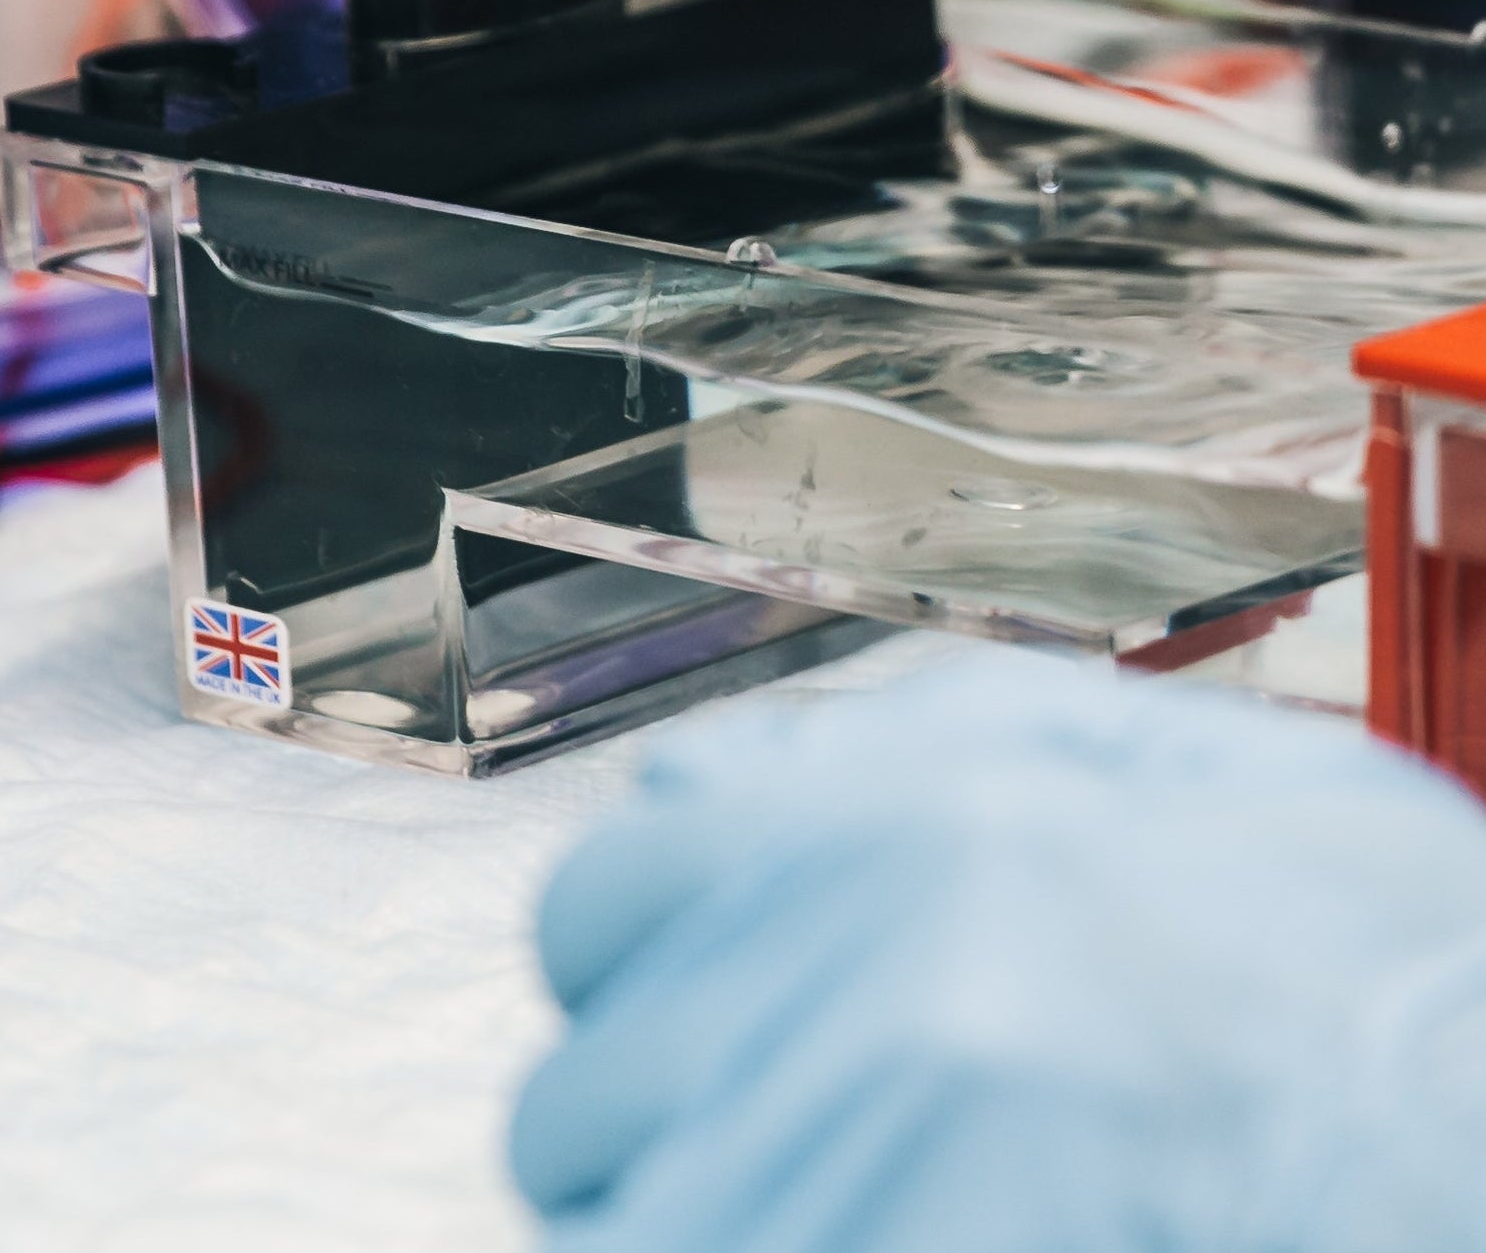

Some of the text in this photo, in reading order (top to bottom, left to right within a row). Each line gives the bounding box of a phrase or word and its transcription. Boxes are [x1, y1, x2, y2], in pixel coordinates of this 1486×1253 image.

[230, 681, 241, 694] IN
[244, 685, 263, 700] THE
[267, 691, 282, 705] UK
